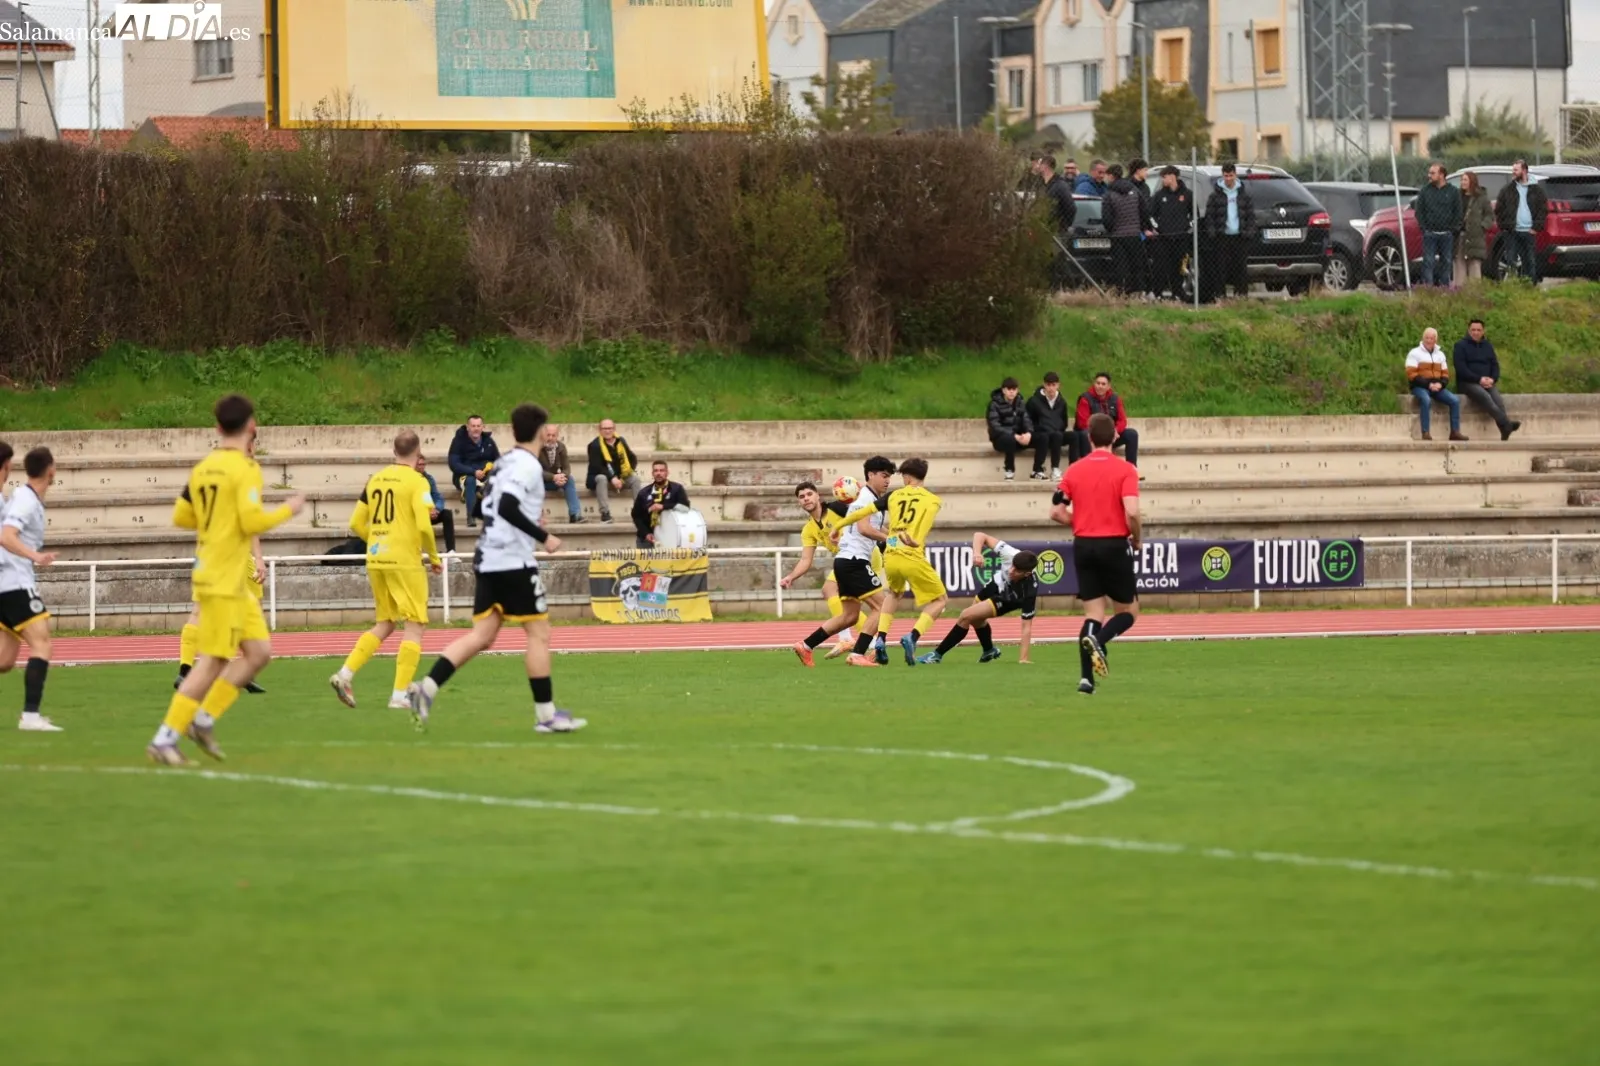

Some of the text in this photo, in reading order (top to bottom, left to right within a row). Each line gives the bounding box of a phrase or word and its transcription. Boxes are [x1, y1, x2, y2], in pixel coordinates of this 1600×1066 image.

[517, 30, 598, 51] RURAL
[199, 484, 217, 532] 17
[372, 488, 394, 524] 20
[897, 498, 920, 524] 15
[1254, 539, 1320, 584] FUTUR
[1136, 575, 1180, 588] ACIÓN
